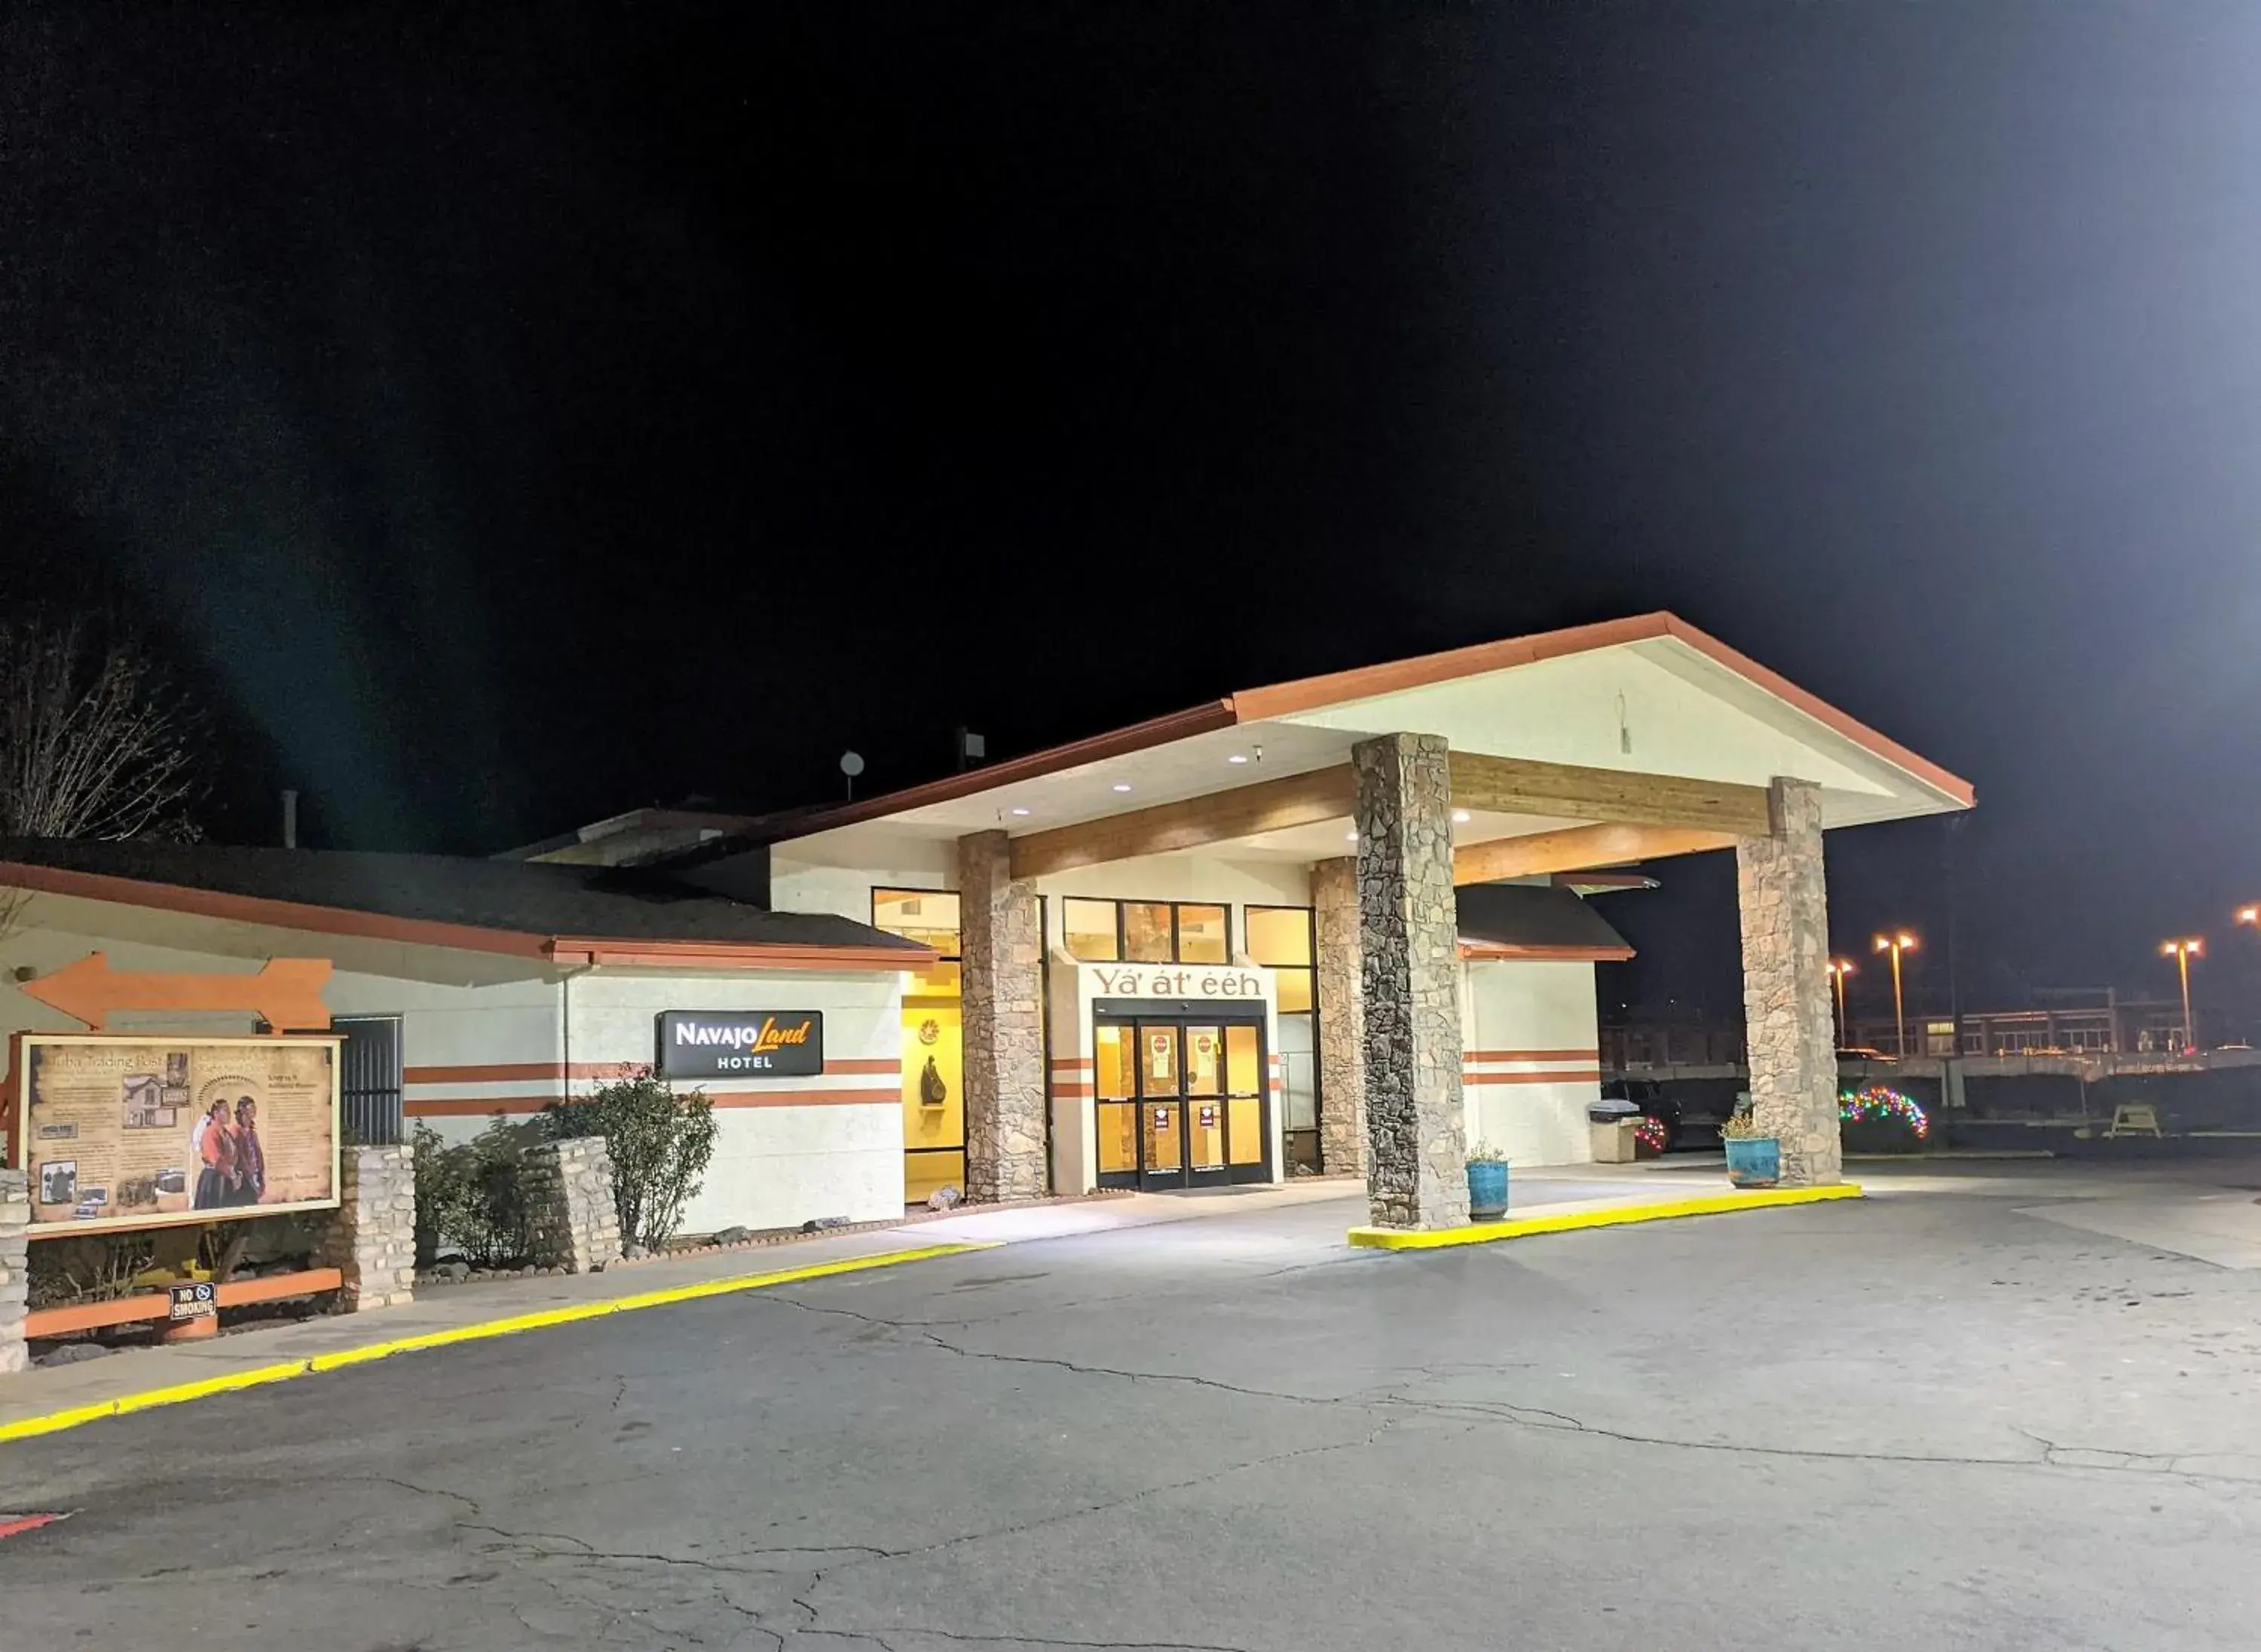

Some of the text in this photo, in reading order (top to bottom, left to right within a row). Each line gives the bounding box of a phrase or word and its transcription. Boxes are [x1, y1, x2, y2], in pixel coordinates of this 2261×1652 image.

[717, 1057, 773, 1069] HOTEL
[179, 1288, 194, 1302] NO
[174, 1299, 213, 1317] SMOKING
